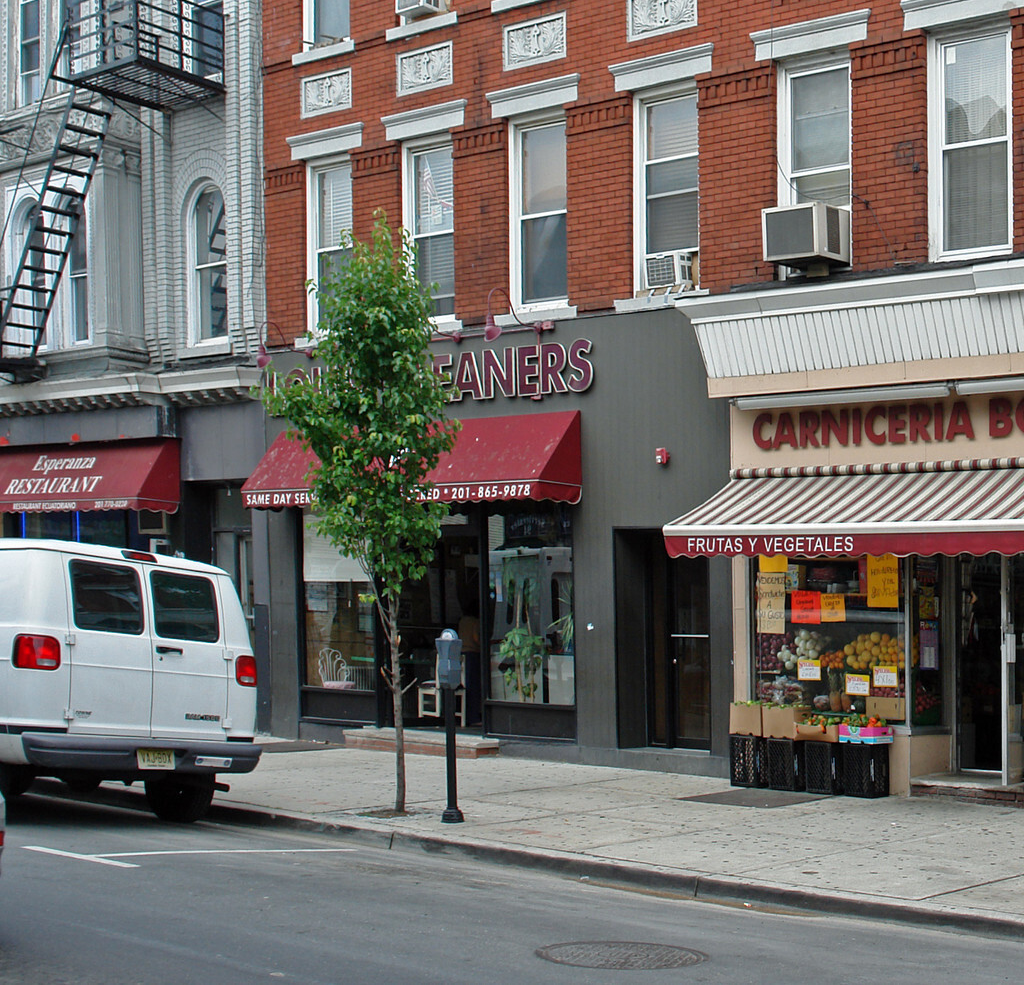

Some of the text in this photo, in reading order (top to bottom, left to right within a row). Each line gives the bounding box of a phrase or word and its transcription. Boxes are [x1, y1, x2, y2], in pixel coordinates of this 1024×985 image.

[752, 400, 976, 451] CARNICERIA
[32, 455, 96, 474] Esperanza
[3, 475, 103, 495] RESTAURANT
[451, 484, 531, 499] 201-865-9878
[246, 492, 270, 505] SAME
[273, 493, 291, 504] DAY
[687, 536, 854, 552] FRUTAS Y VEGETALES
